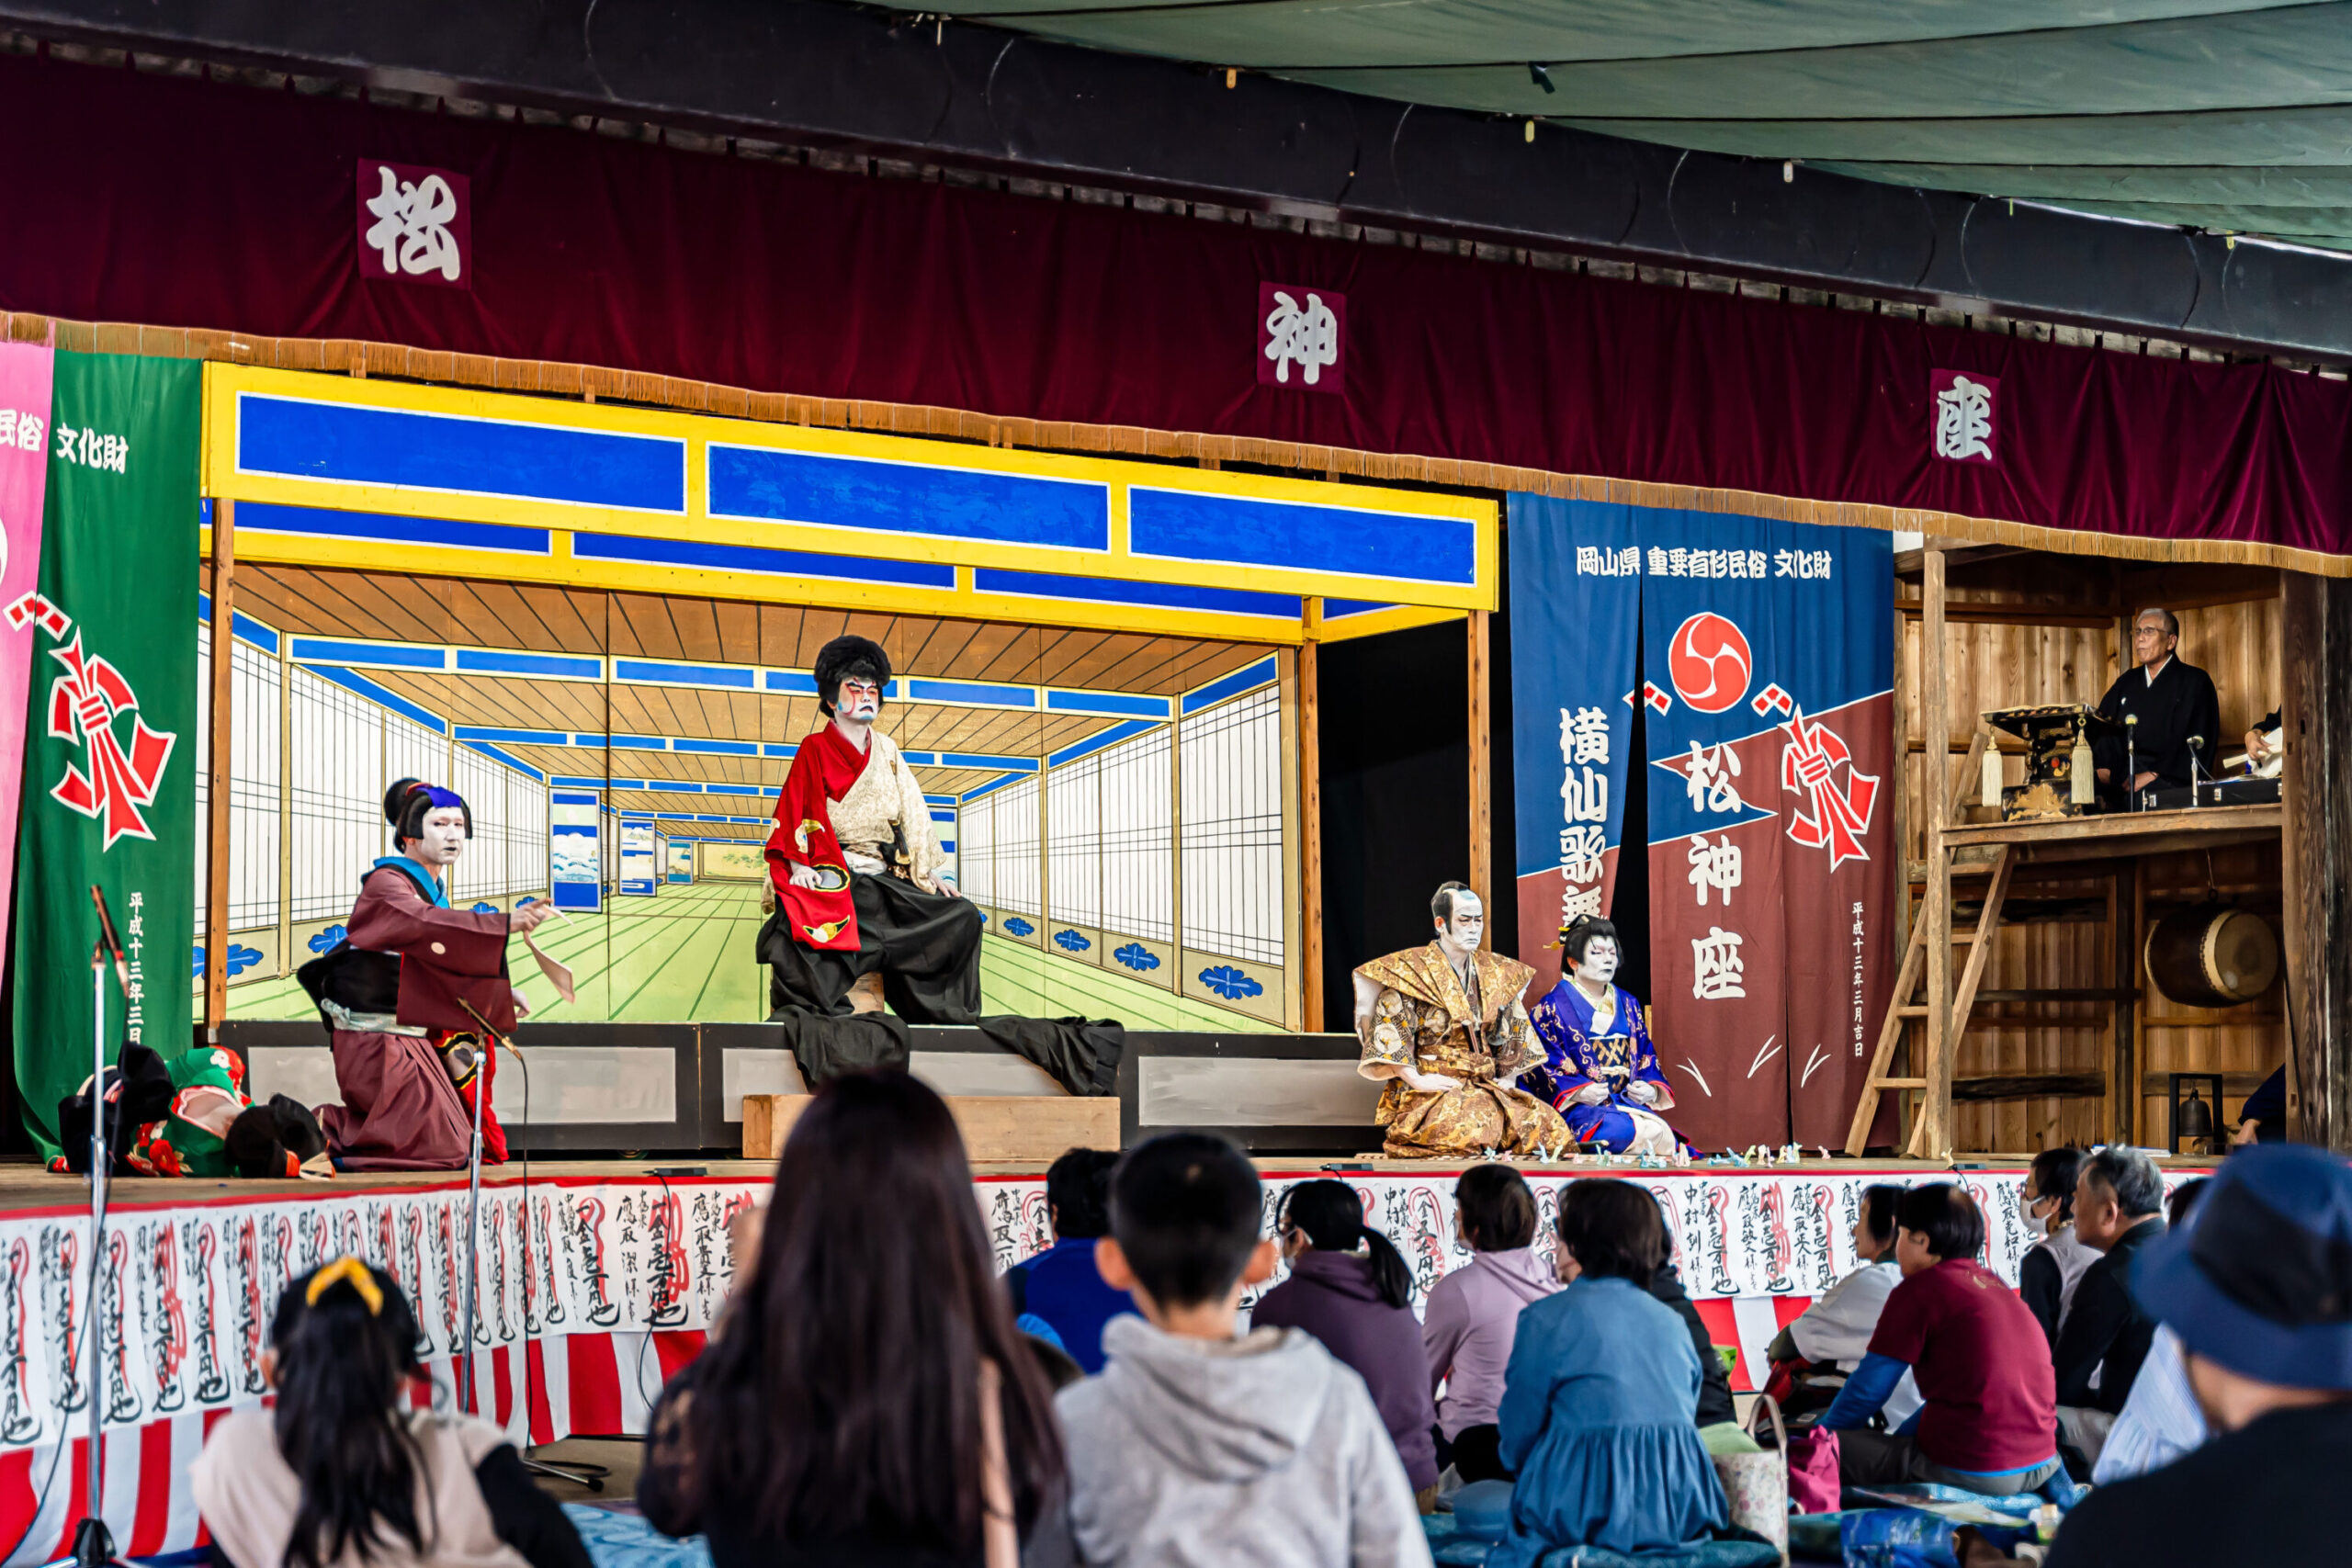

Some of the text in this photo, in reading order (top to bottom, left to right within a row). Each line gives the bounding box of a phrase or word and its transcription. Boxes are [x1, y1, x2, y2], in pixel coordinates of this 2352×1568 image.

[0, 409, 130, 475] 民俗 文化財
[1264, 290, 1338, 385] 神
[1936, 375, 1993, 461] 座
[1576, 546, 1833, 581] 岡山県 重要有形民俗 文化財
[1686, 739, 1747, 1000] 松神座
[1851, 901, 1865, 1057] 平成十三年三月吉日
